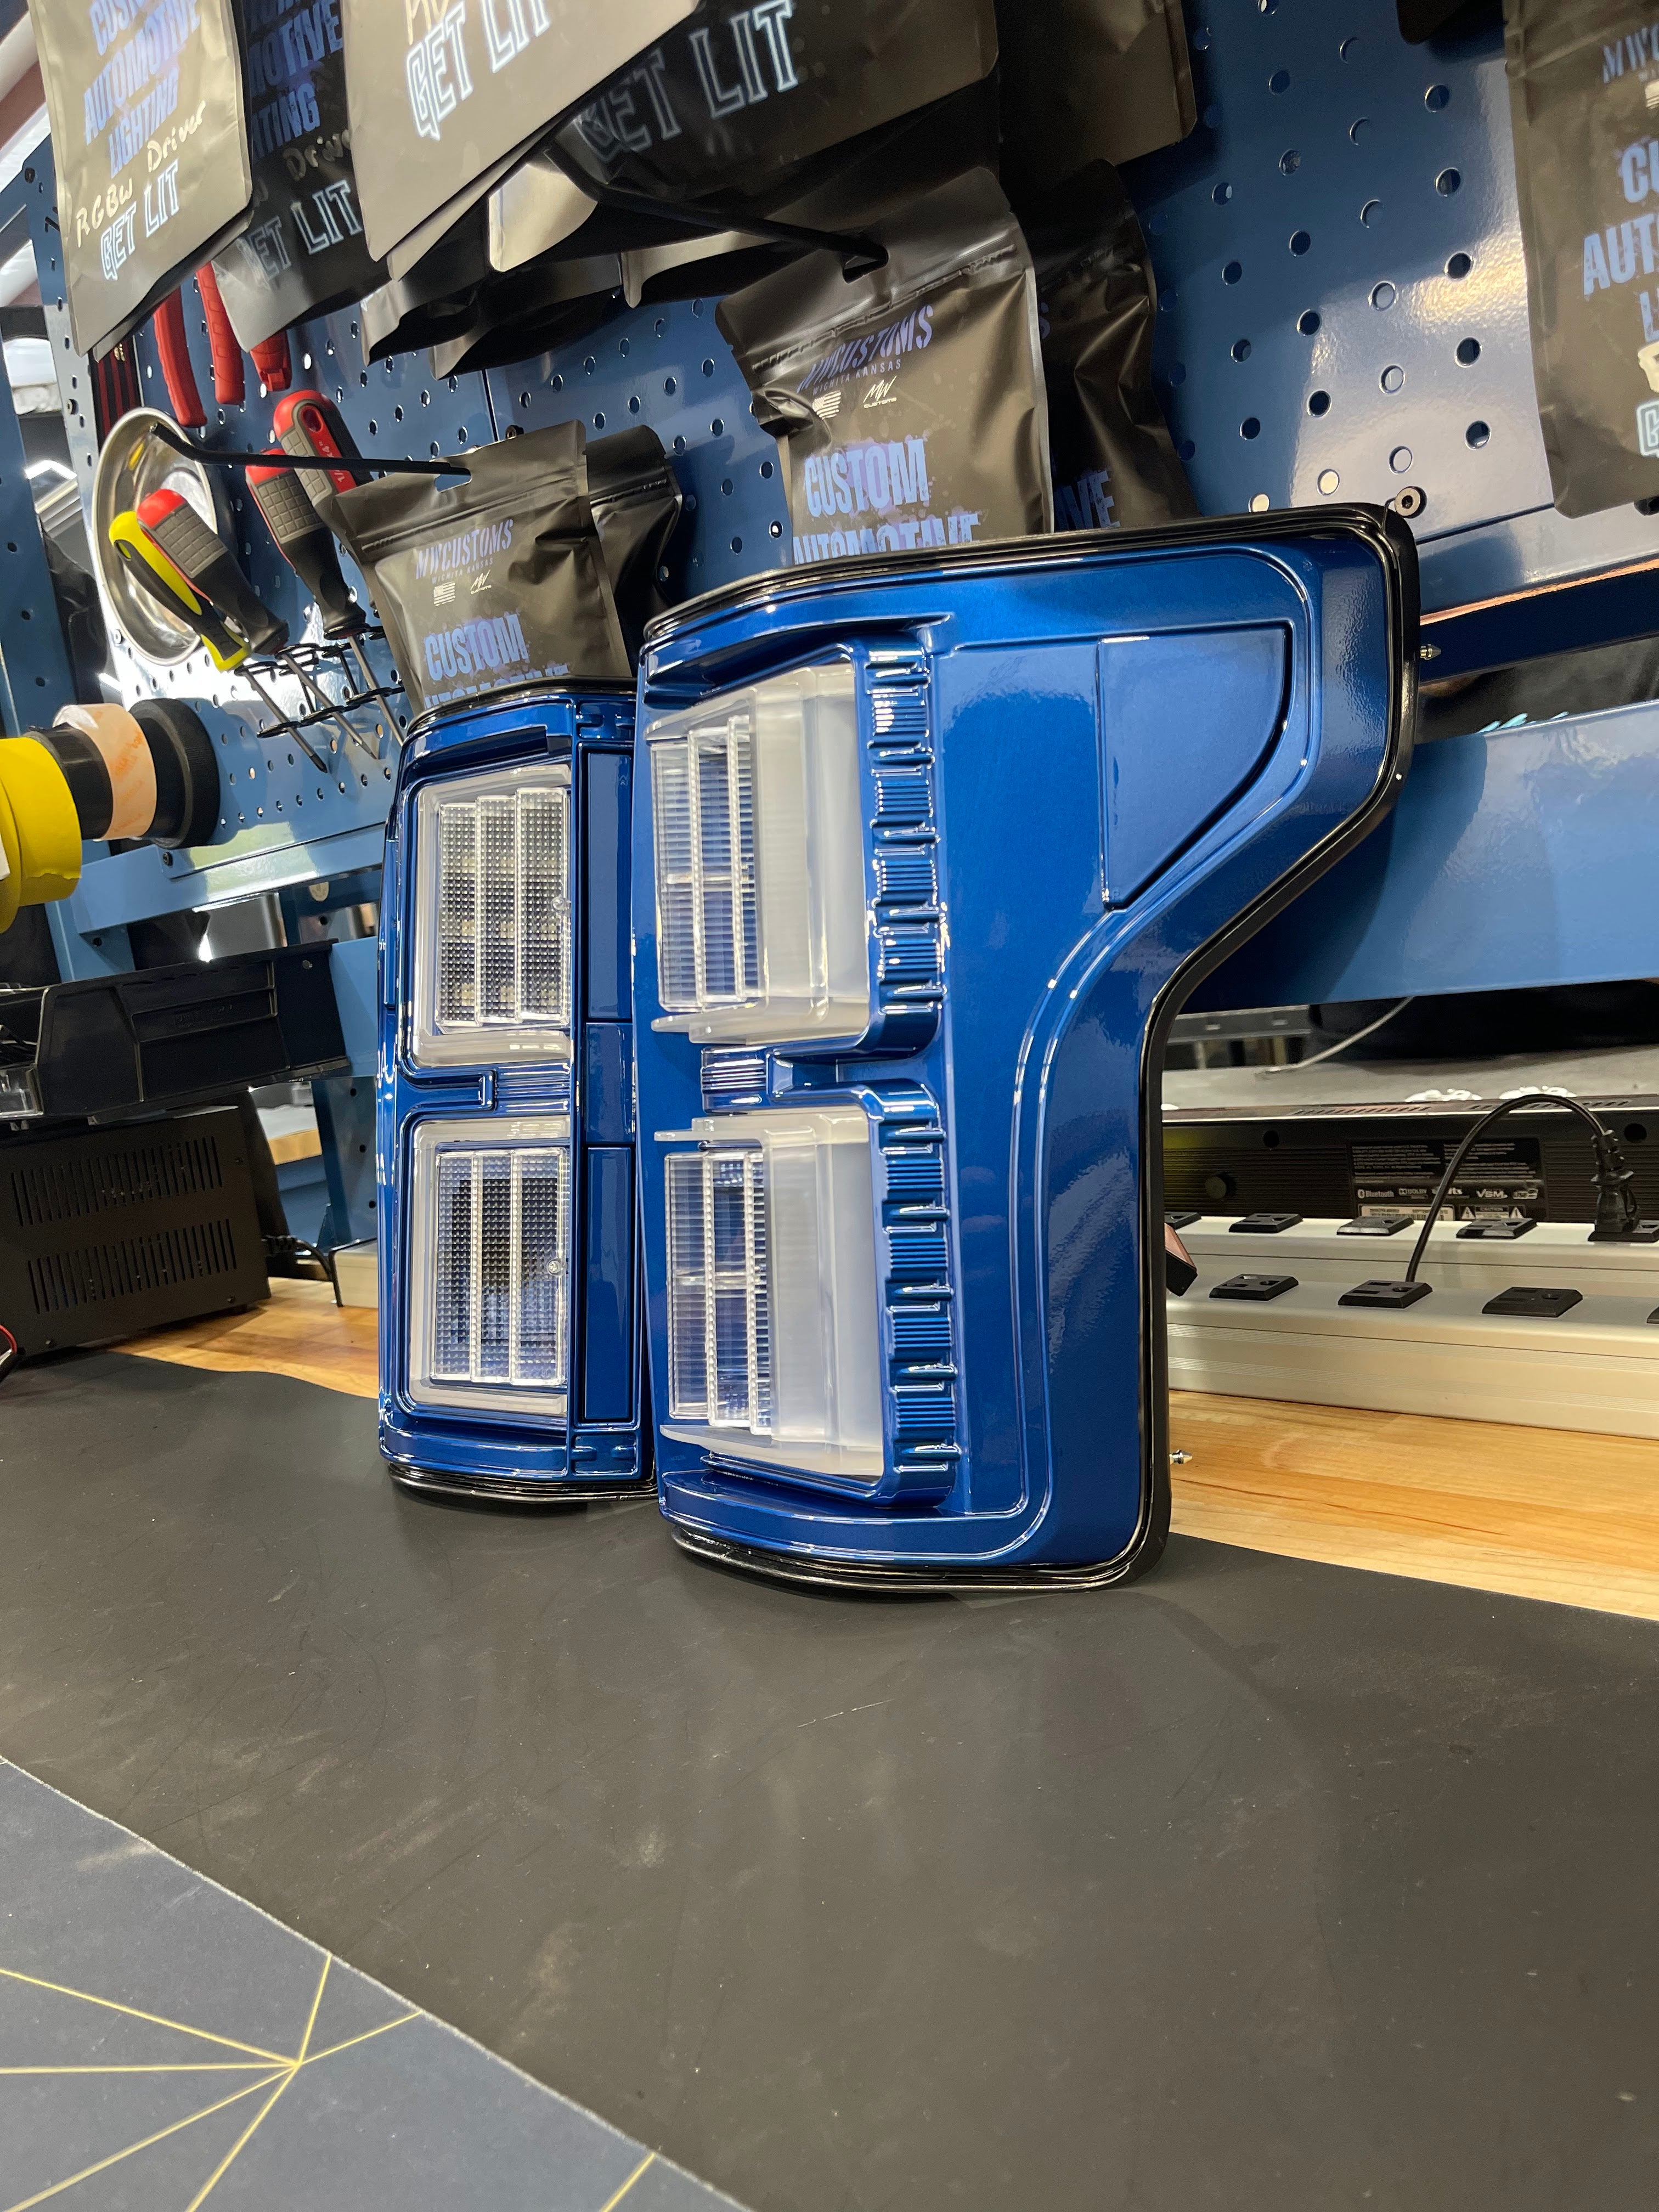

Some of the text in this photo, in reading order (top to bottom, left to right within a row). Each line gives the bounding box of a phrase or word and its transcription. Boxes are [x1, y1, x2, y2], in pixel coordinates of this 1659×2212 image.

[407, 0, 474, 141] GET
[688, 0, 799, 119] LIT
[108, 66, 179, 179] LIGHTING
[146, 100, 206, 173] Driver
[100, 158, 180, 281] GET LIT
[290, 179, 363, 255] LIT
[812, 358, 901, 396] WICHITA KANSAS
[804, 439, 930, 518] CUSTOM
[425, 614, 529, 681] CUSTOM
